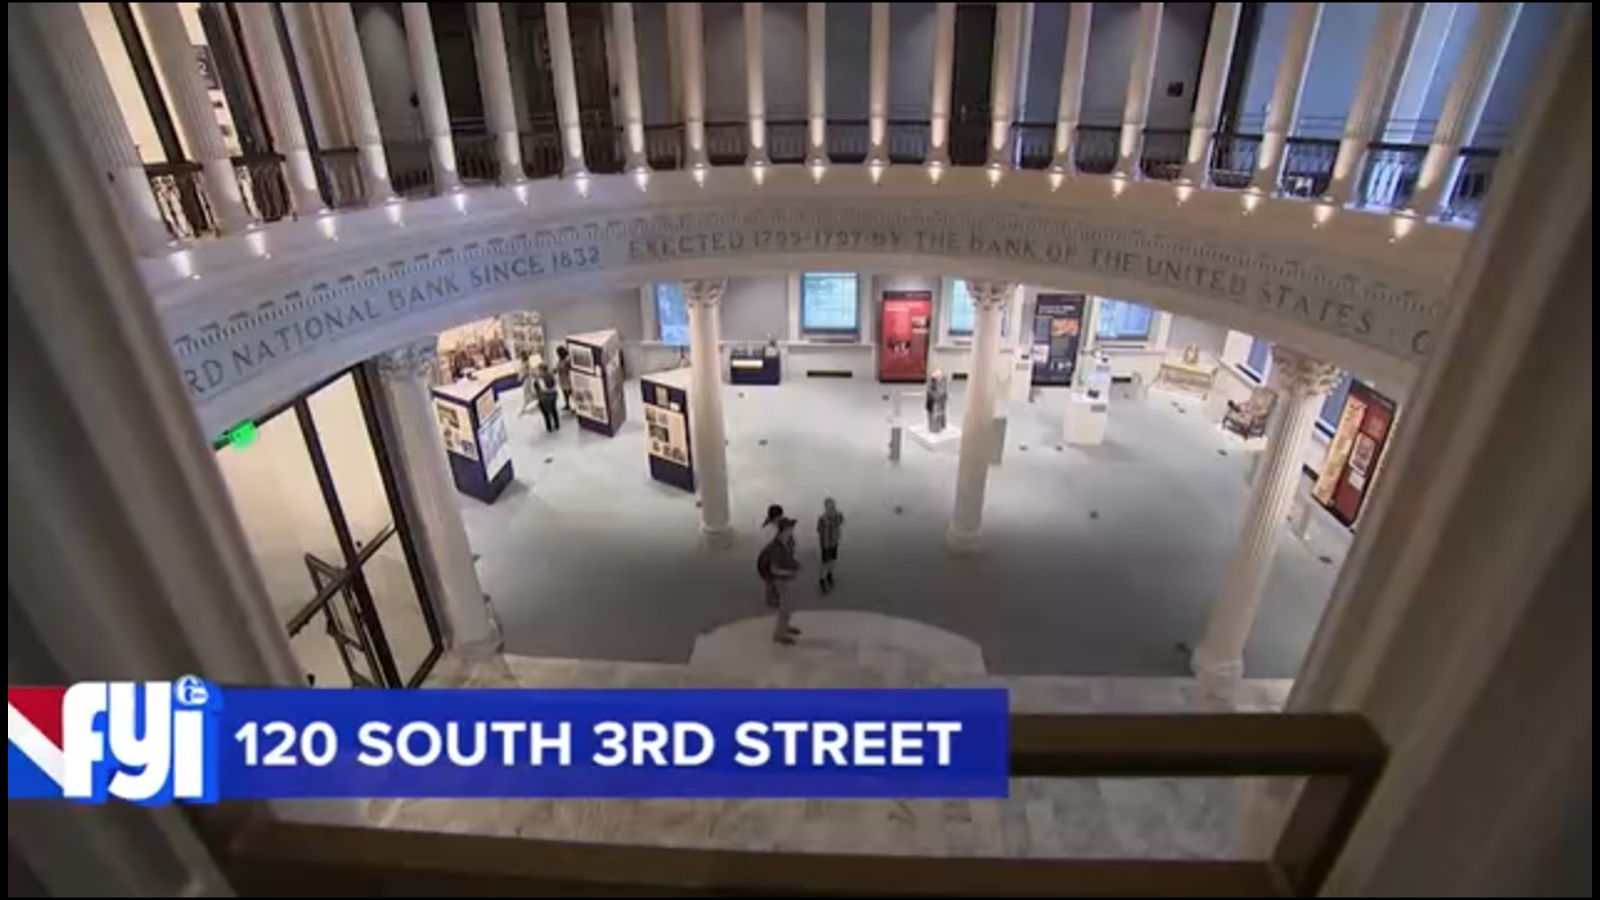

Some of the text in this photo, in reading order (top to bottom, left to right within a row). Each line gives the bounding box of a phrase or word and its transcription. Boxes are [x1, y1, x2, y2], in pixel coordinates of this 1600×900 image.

[231, 298, 382, 375] NATIONAL
[387, 273, 461, 312] BANK
[469, 255, 545, 287] SINCE
[551, 245, 601, 271] 1832
[628, 231, 744, 261] ERECTED
[914, 230, 960, 250] THE
[970, 232, 1035, 259] BANK
[1045, 240, 1076, 262] OF
[1091, 249, 1140, 272] THE
[1145, 255, 1247, 297] UNITED
[1259, 283, 1373, 334] STATES
